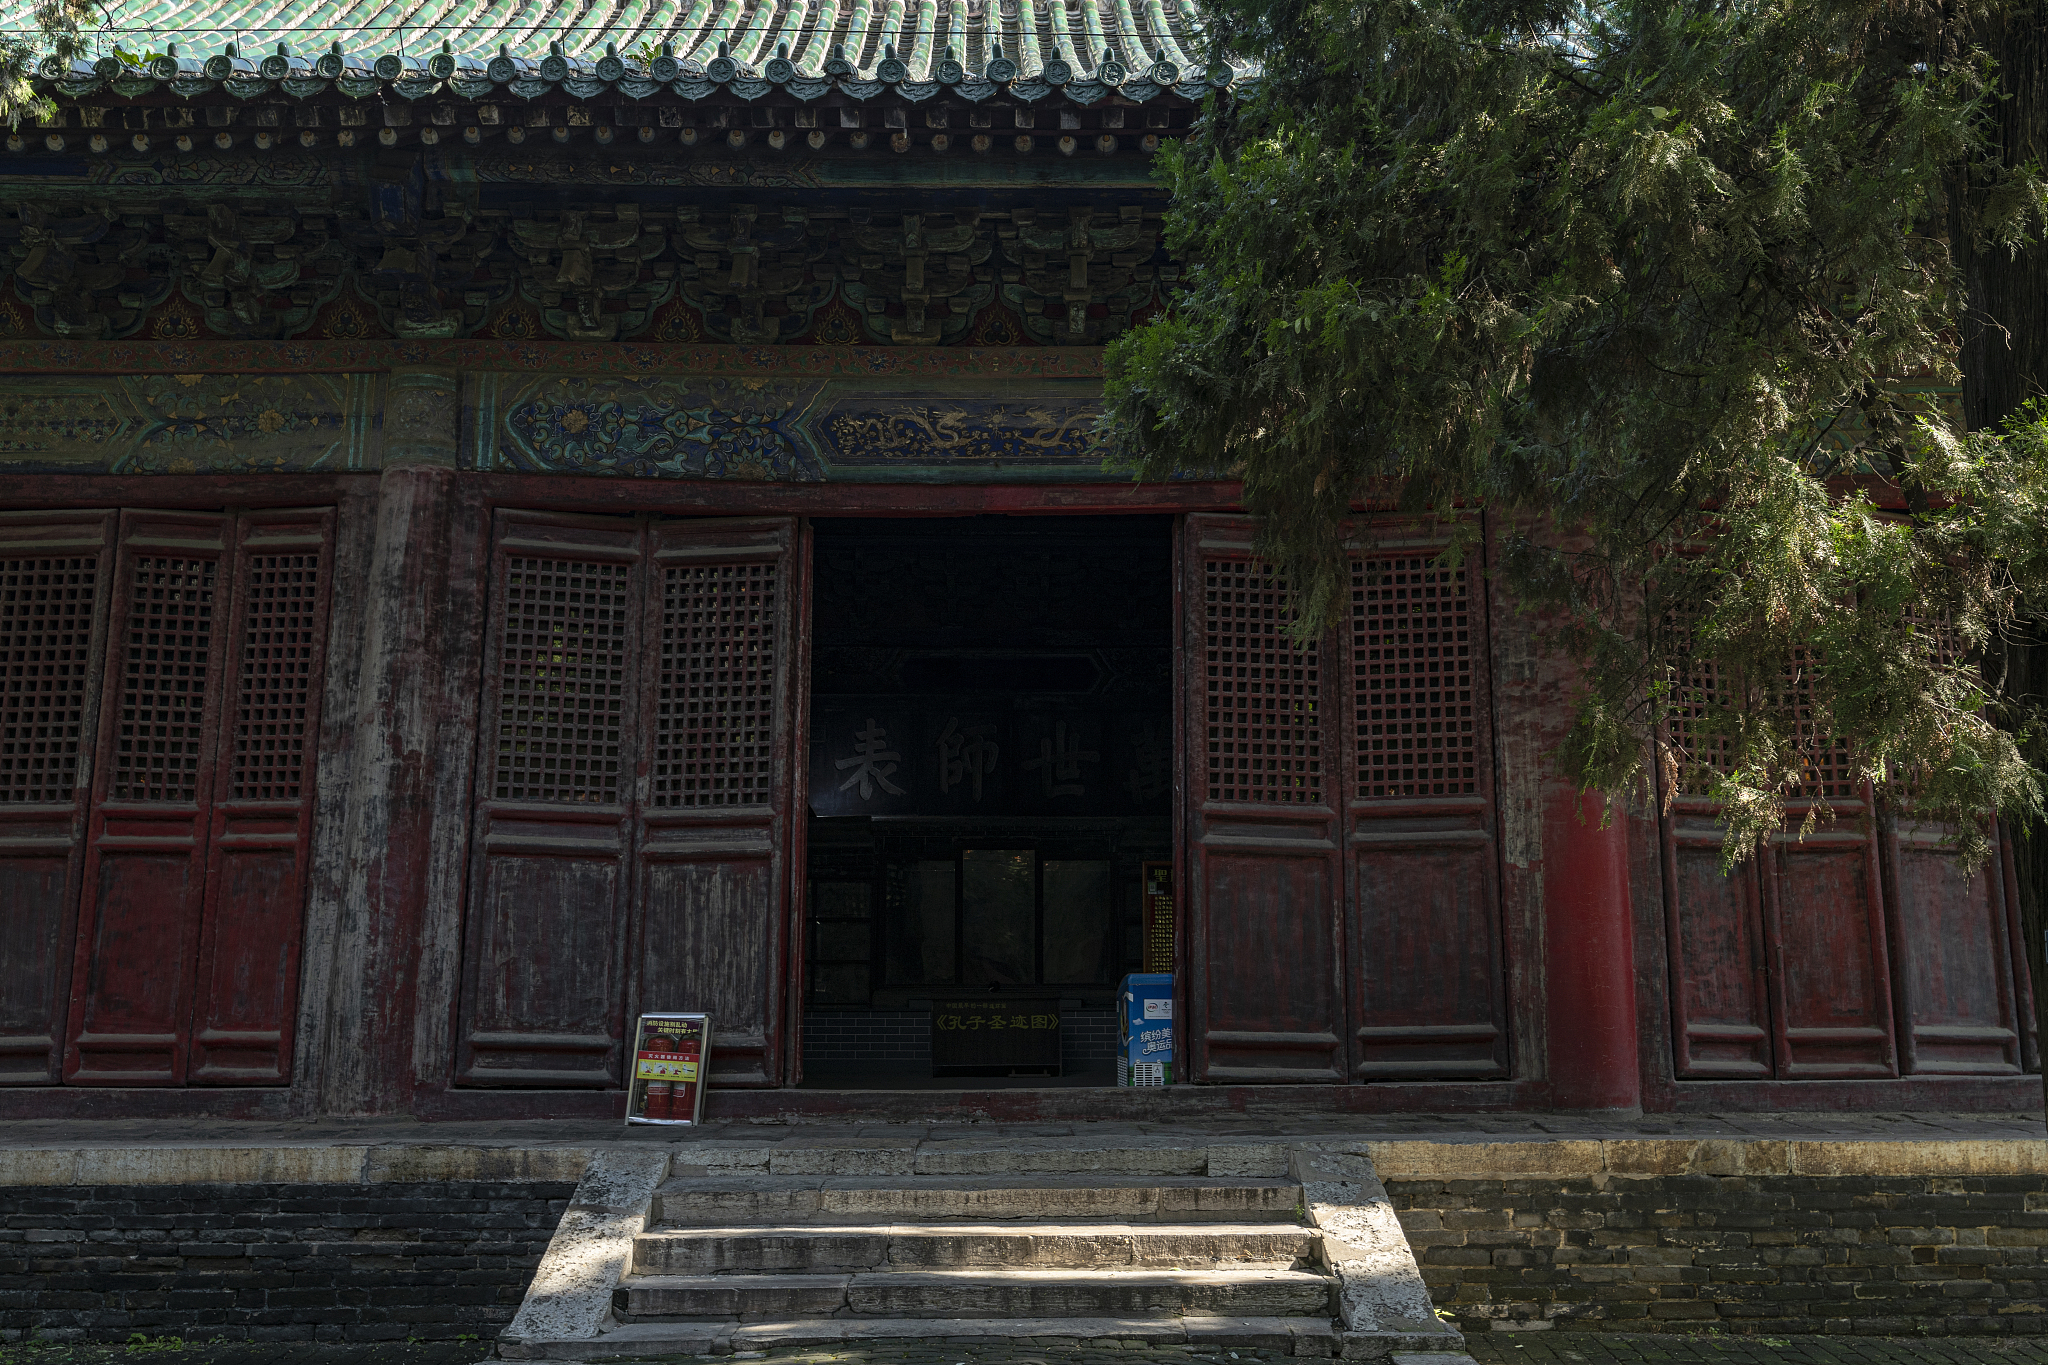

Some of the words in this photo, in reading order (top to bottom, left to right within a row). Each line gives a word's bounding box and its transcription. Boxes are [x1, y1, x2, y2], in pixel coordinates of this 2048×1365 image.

[937, 1014, 1059, 1030] 《孔子圣迹图》
